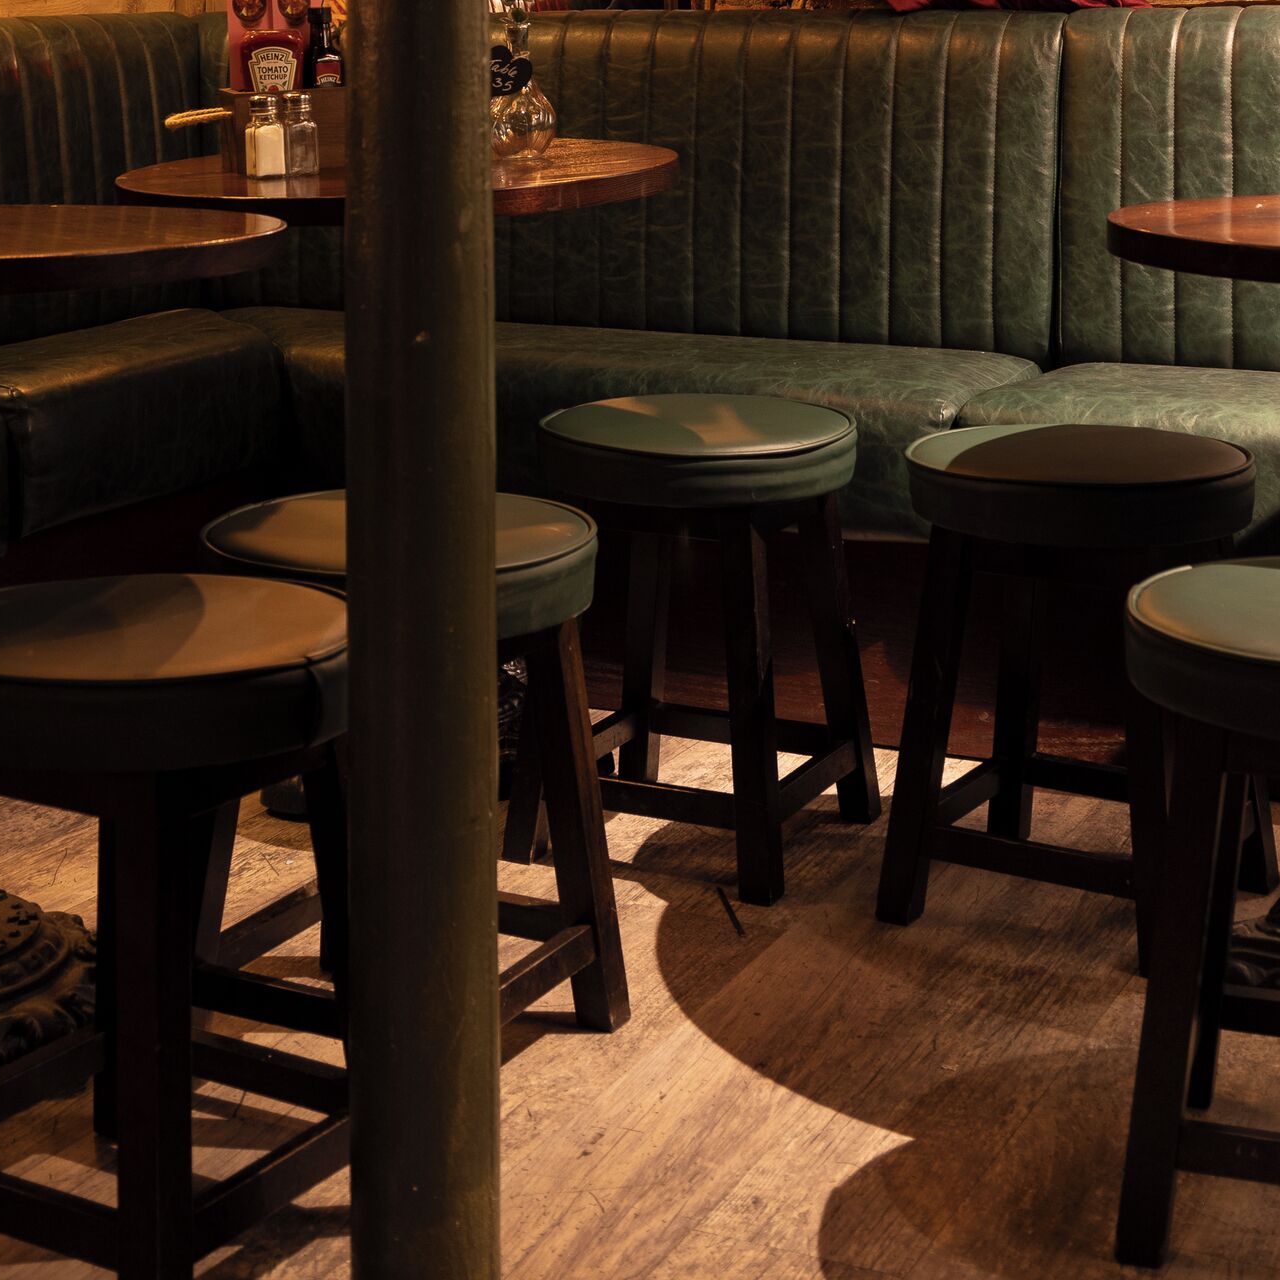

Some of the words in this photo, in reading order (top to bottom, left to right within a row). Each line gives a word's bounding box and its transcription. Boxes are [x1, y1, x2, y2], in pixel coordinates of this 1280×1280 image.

[260, 53, 285, 62] HEINZ
[257, 66, 289, 74] TOMATO
[492, 77, 514, 91] 35
